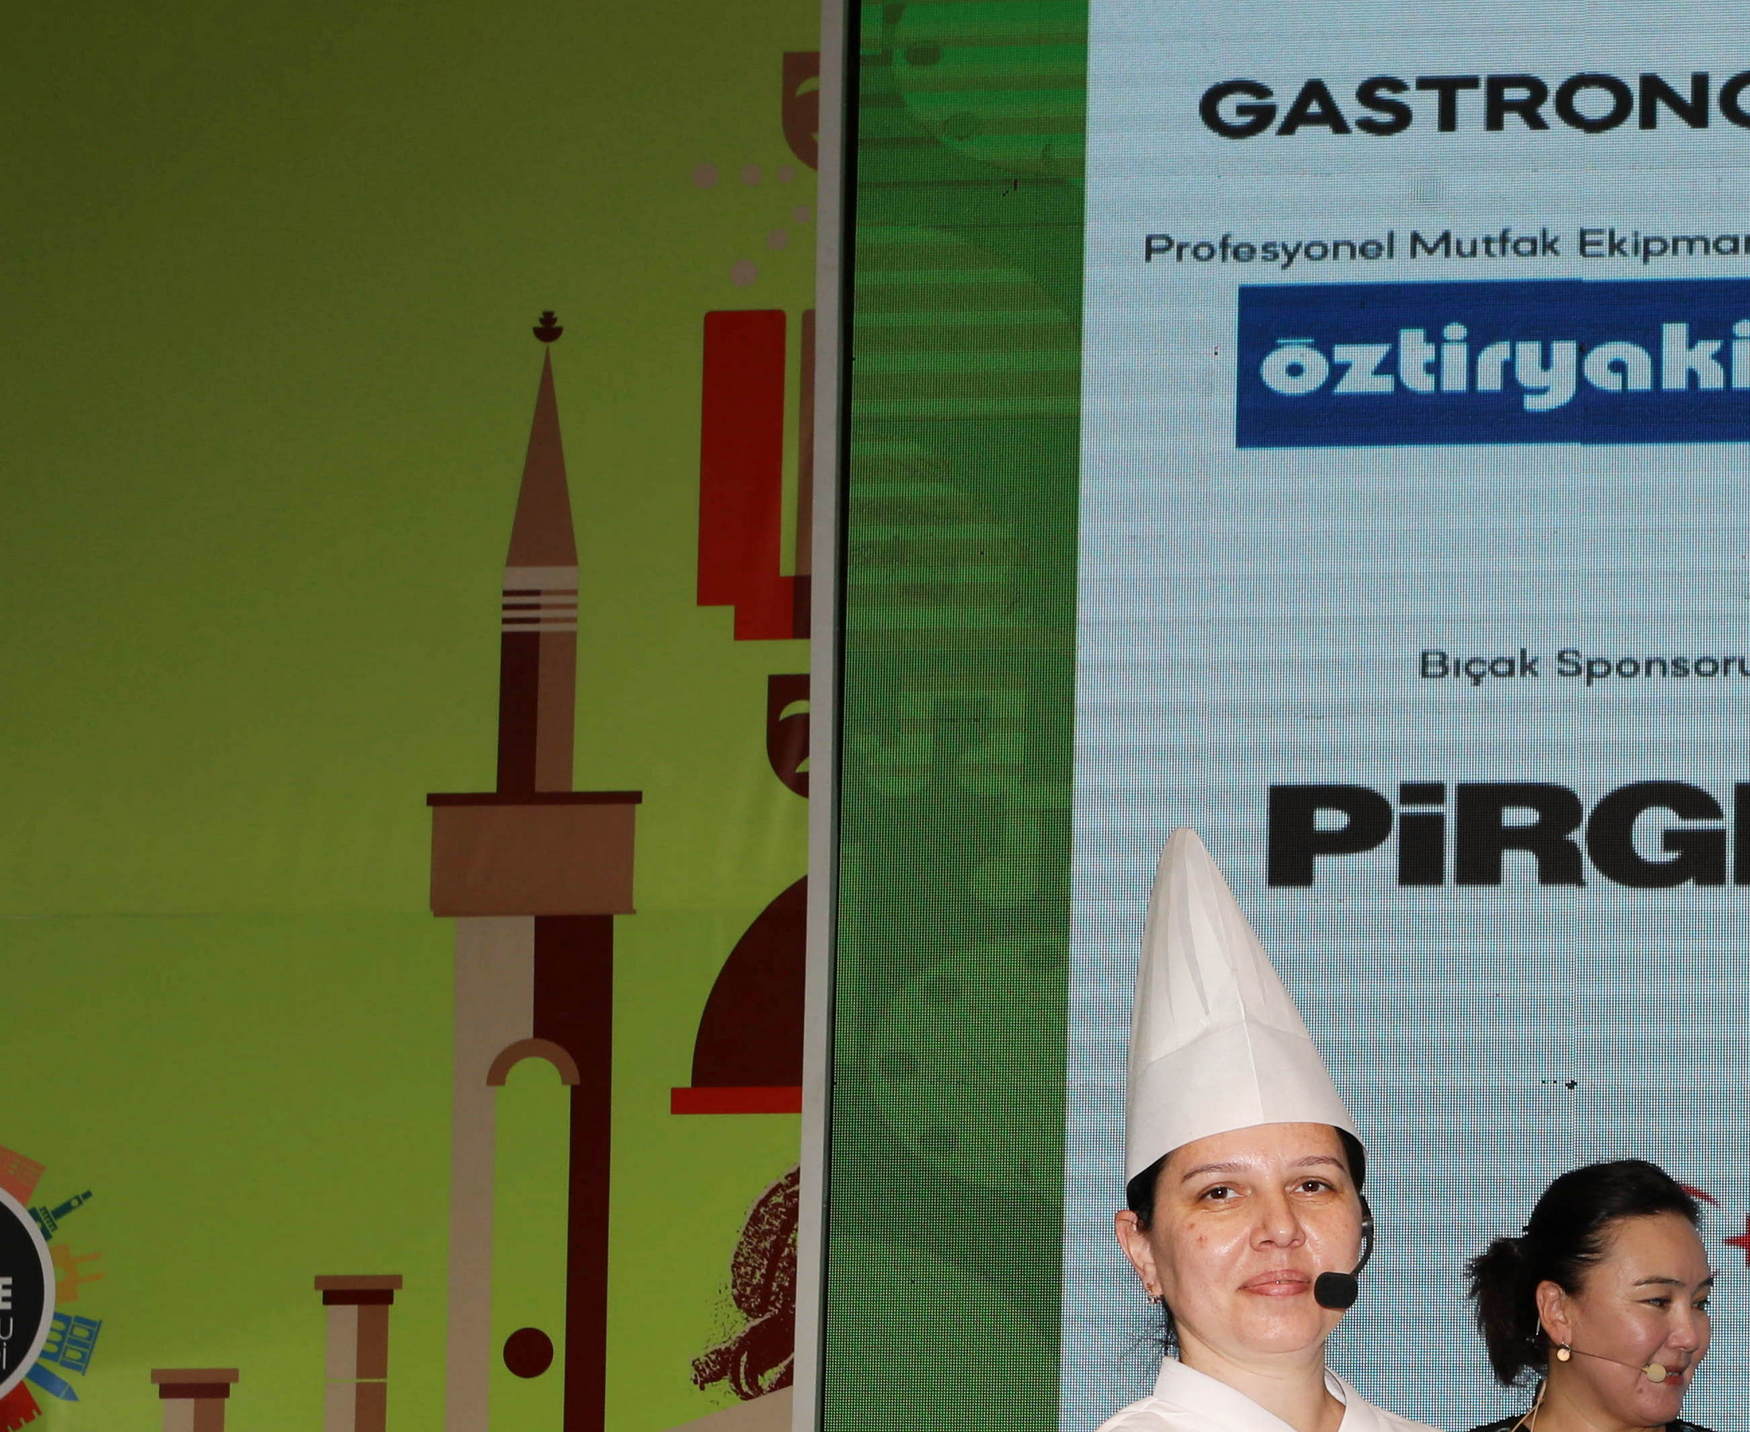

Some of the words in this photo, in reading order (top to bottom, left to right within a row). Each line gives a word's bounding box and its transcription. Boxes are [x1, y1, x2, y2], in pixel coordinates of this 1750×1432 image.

[1144, 231, 1396, 271] Profesyonel
[1409, 228, 1560, 259] Mutfak
[1419, 648, 1539, 687] Bıçak
